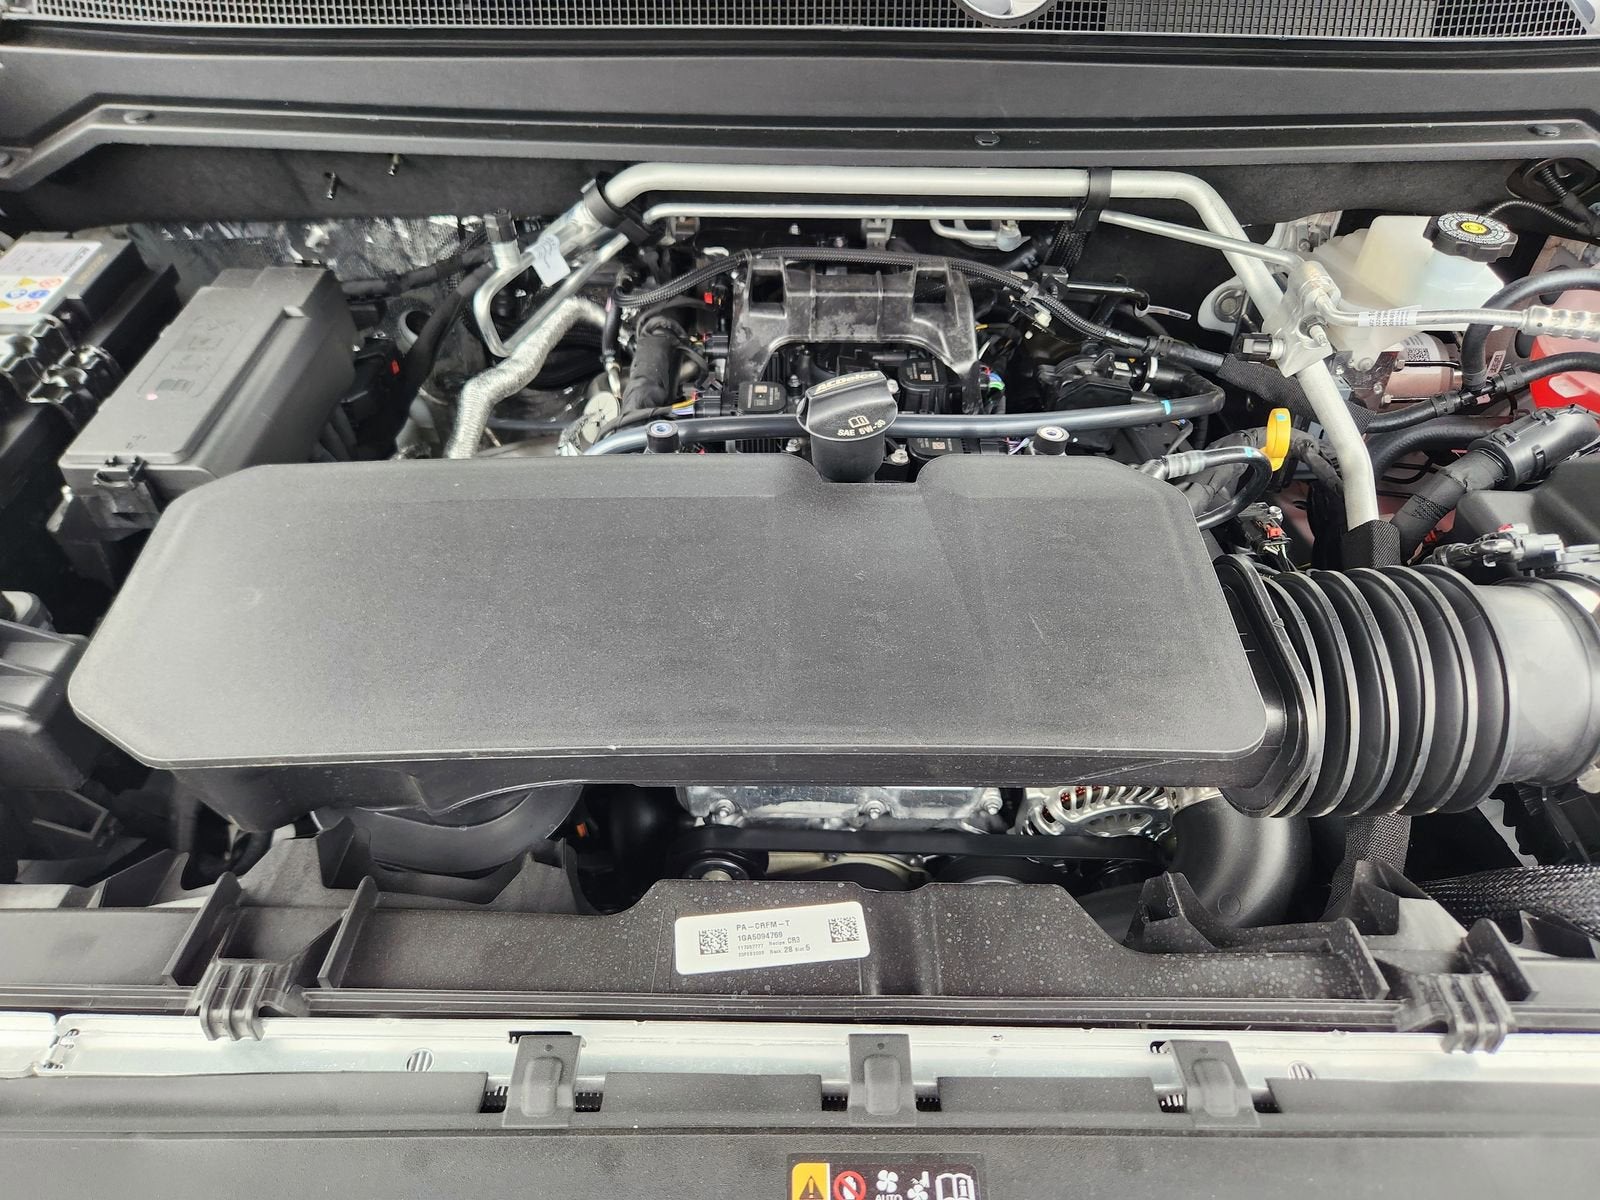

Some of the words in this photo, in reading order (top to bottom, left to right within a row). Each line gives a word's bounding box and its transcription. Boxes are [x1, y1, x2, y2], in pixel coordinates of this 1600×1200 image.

[837, 429, 856, 437] SAE
[736, 920, 790, 931] PA-CRFM-T
[784, 945, 793, 953] 28
[805, 943, 811, 951] 5
